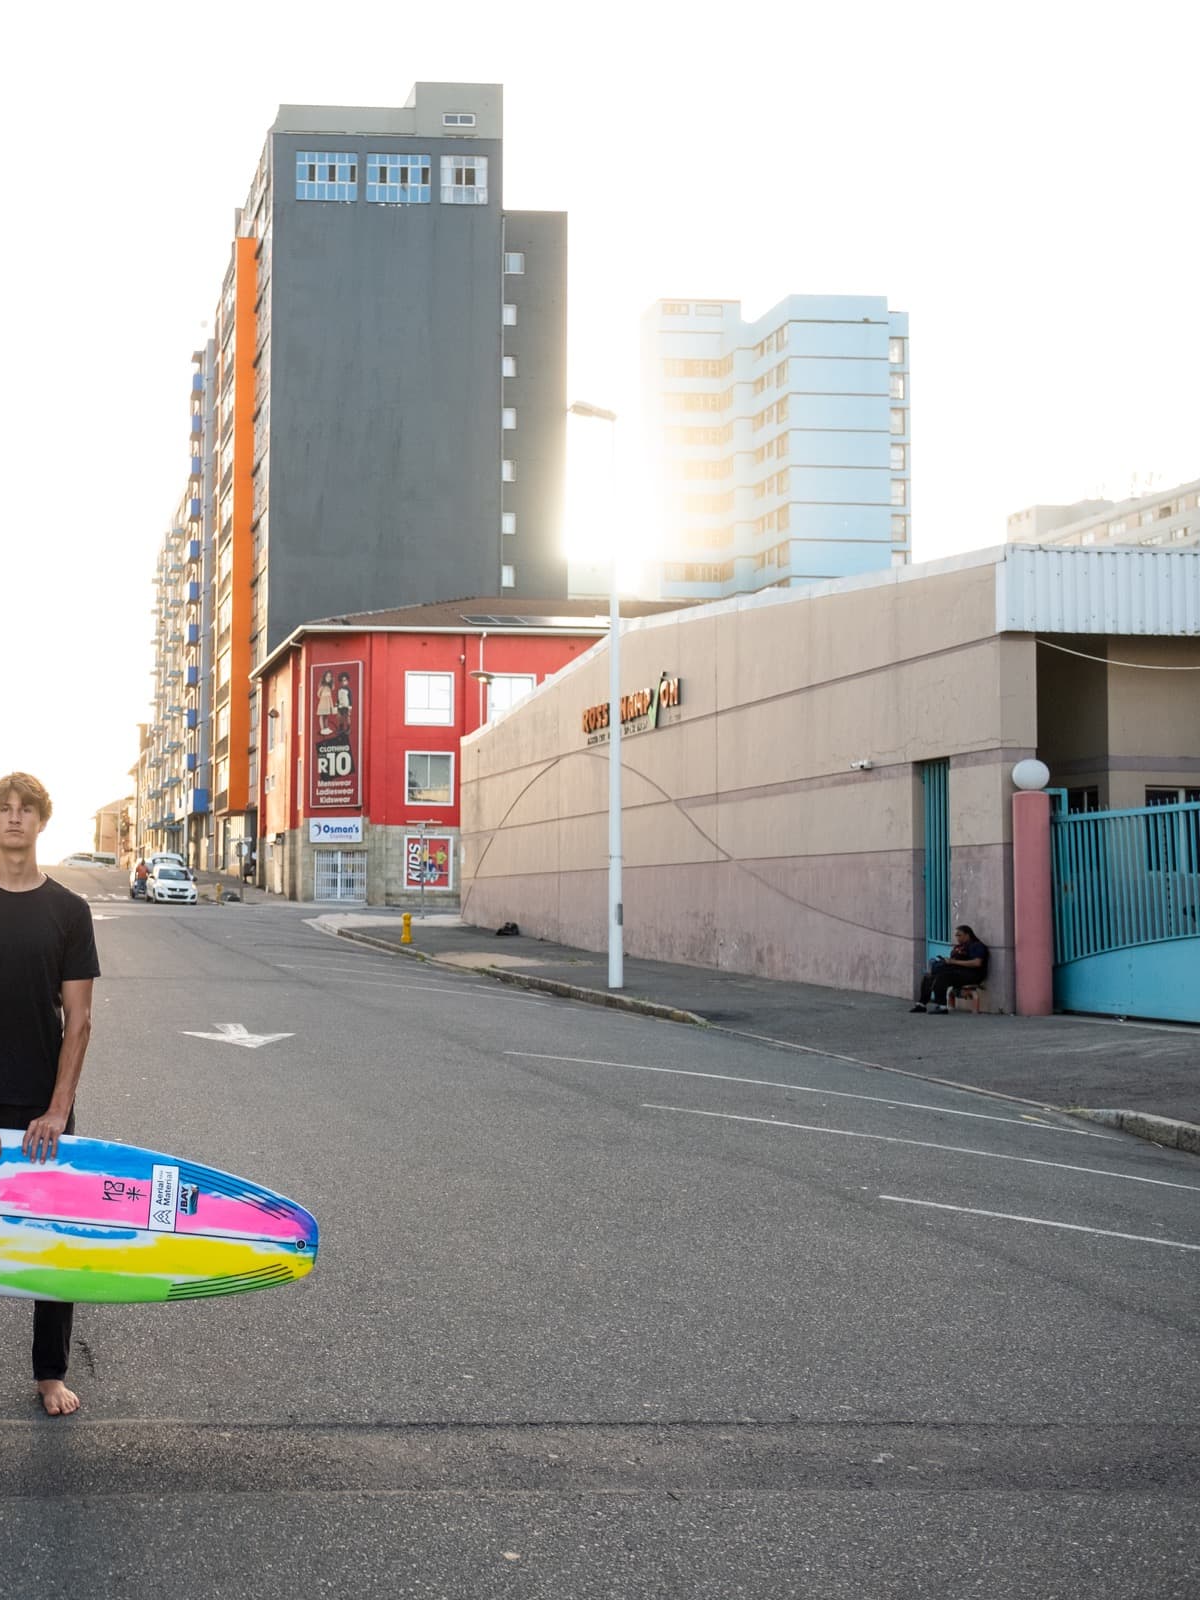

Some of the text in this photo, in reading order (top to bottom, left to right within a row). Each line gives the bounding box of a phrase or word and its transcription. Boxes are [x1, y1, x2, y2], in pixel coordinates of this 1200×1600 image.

[318, 751, 352, 776] R10
[316, 788, 354, 796] Ladieswear
[317, 780, 351, 788] Menswear
[320, 796, 350, 804] Kidswear
[323, 824, 360, 834] Osman's
[408, 842, 423, 882] KIDS
[156, 1180, 164, 1205] Aerial
[164, 1171, 173, 1206] Material
[180, 1186, 188, 1214] JBAY
